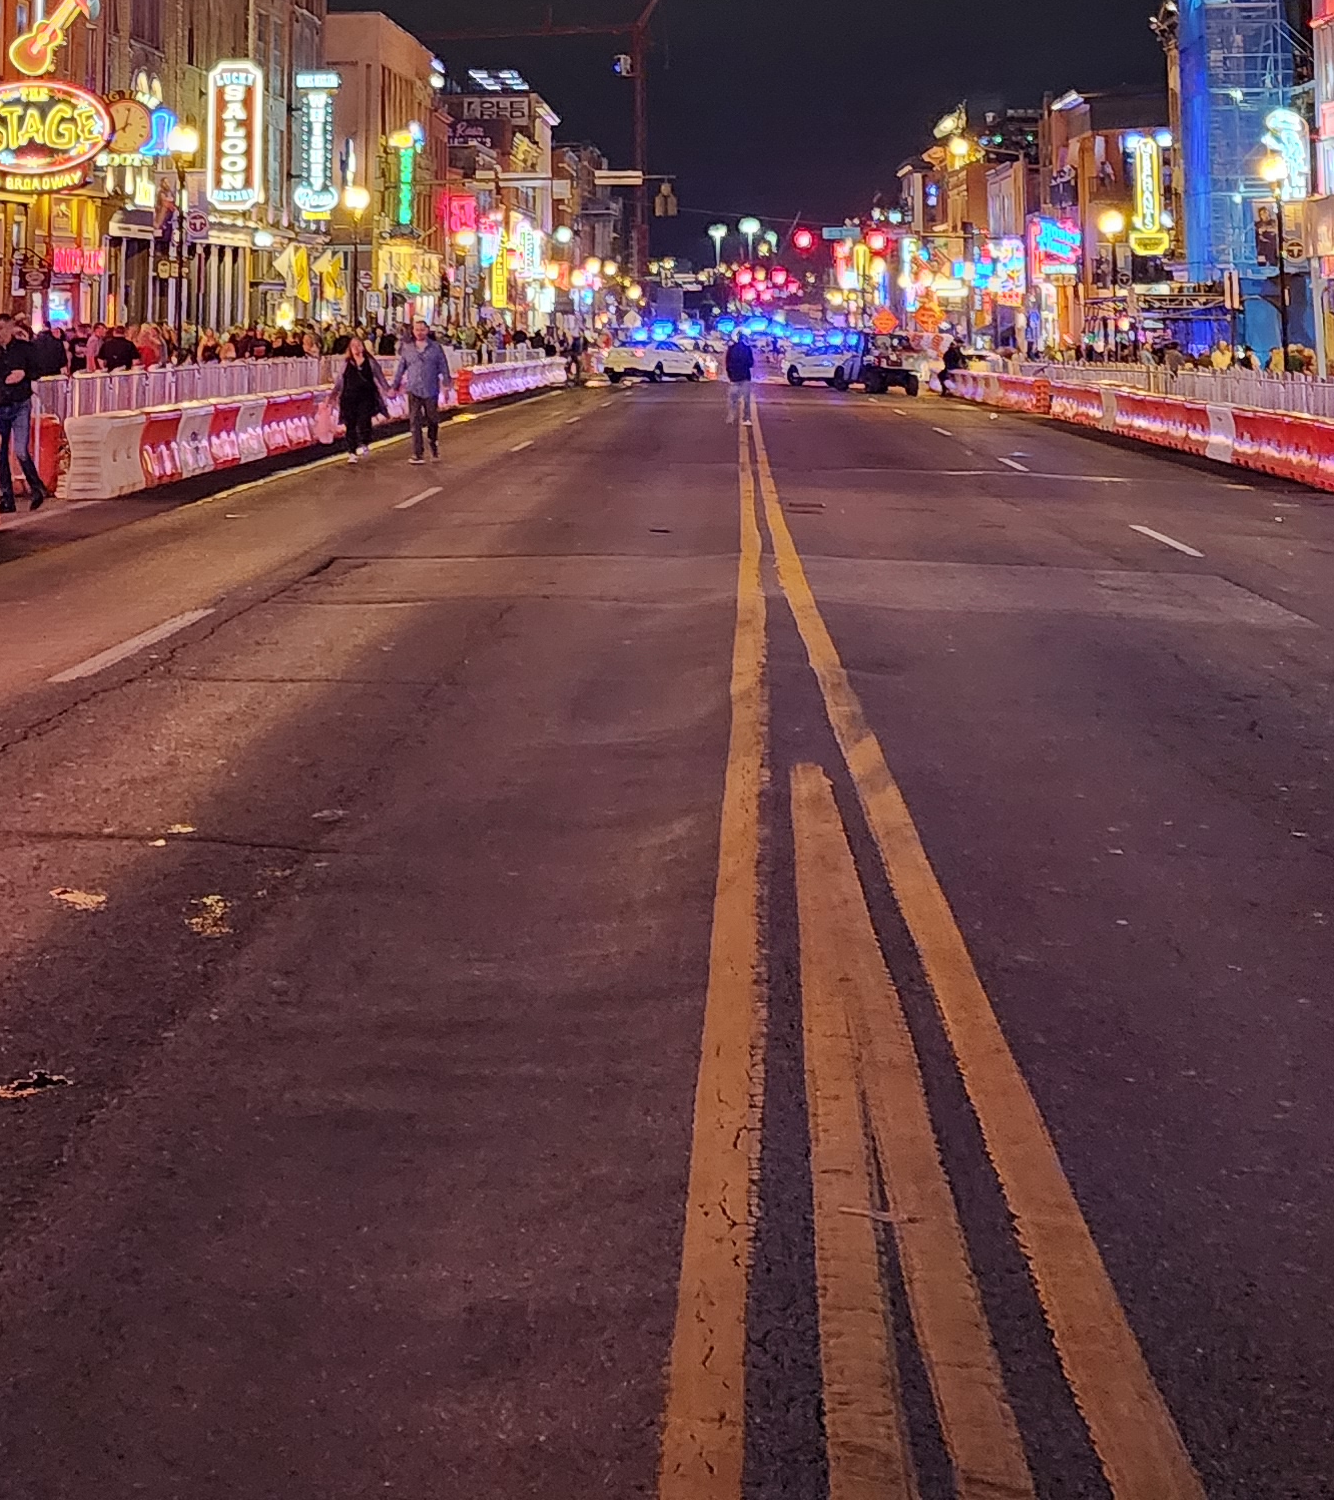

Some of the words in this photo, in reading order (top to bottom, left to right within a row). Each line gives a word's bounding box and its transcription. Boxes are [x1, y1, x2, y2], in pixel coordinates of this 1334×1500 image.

[214, 72, 257, 87] LUCKY
[20, 87, 50, 102] THE
[220, 84, 248, 191] SALOON
[95, 152, 155, 168] BOOTS
[6, 171, 83, 191] BROADWAY
